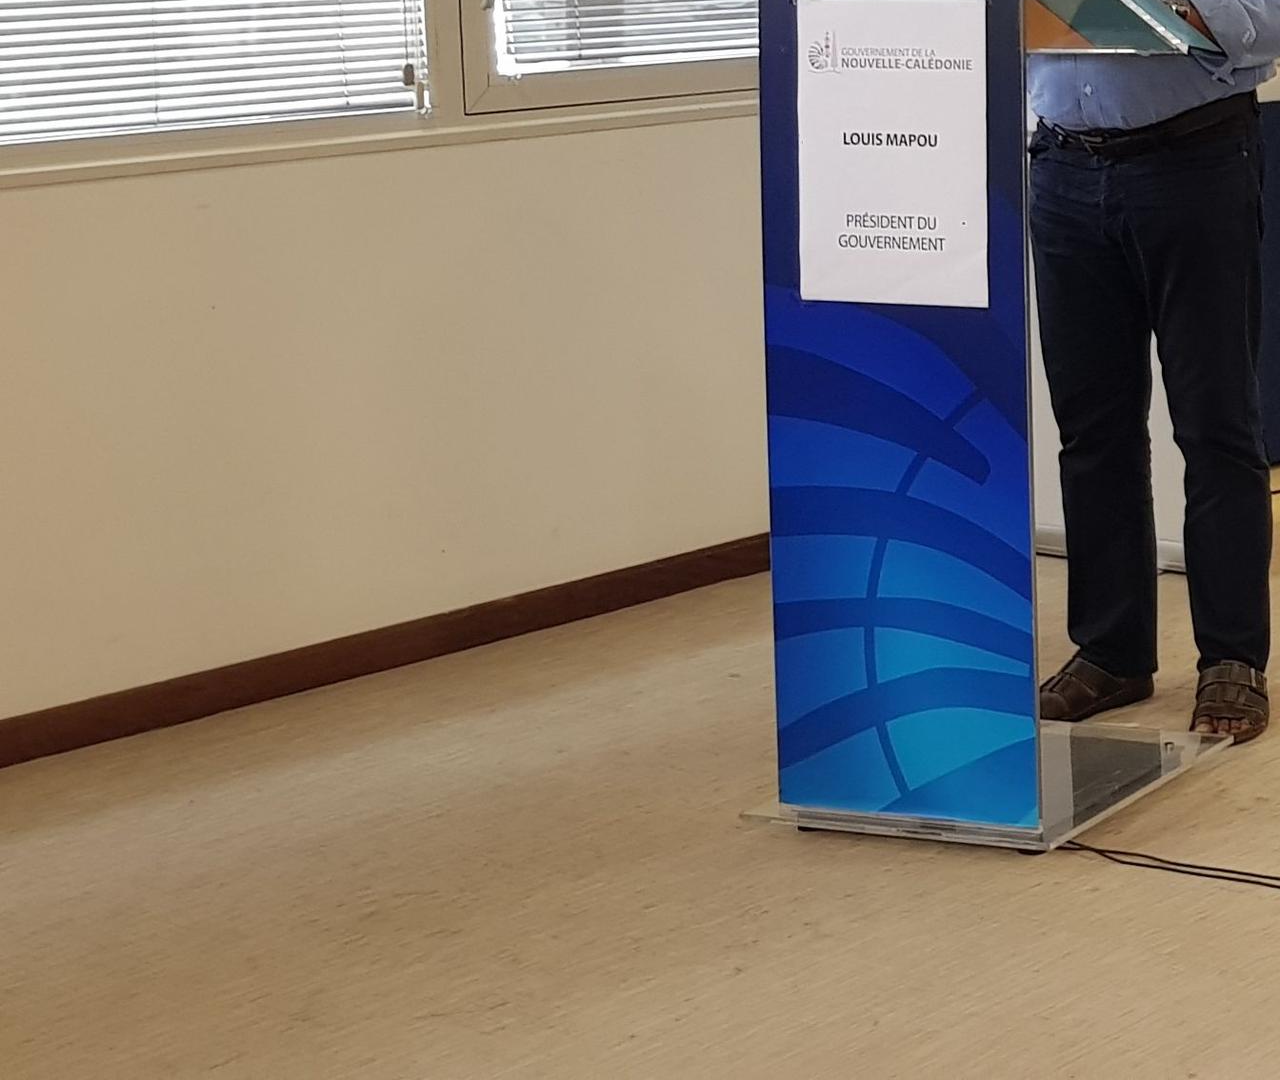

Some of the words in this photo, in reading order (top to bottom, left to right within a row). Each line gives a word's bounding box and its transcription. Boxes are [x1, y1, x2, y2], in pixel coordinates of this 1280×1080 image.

[841, 48, 911, 57] GOUVERNEMENT
[911, 49, 923, 57] DE
[925, 49, 935, 57] LA
[841, 56, 972, 70] NOUVELLE-CALÉDONIE
[843, 132, 882, 146] LOUIS
[886, 134, 938, 147] MAPOU
[846, 213, 914, 229] PRÉSIDENT
[917, 217, 936, 230] DU
[839, 234, 945, 251] GOUVERNEMENT
